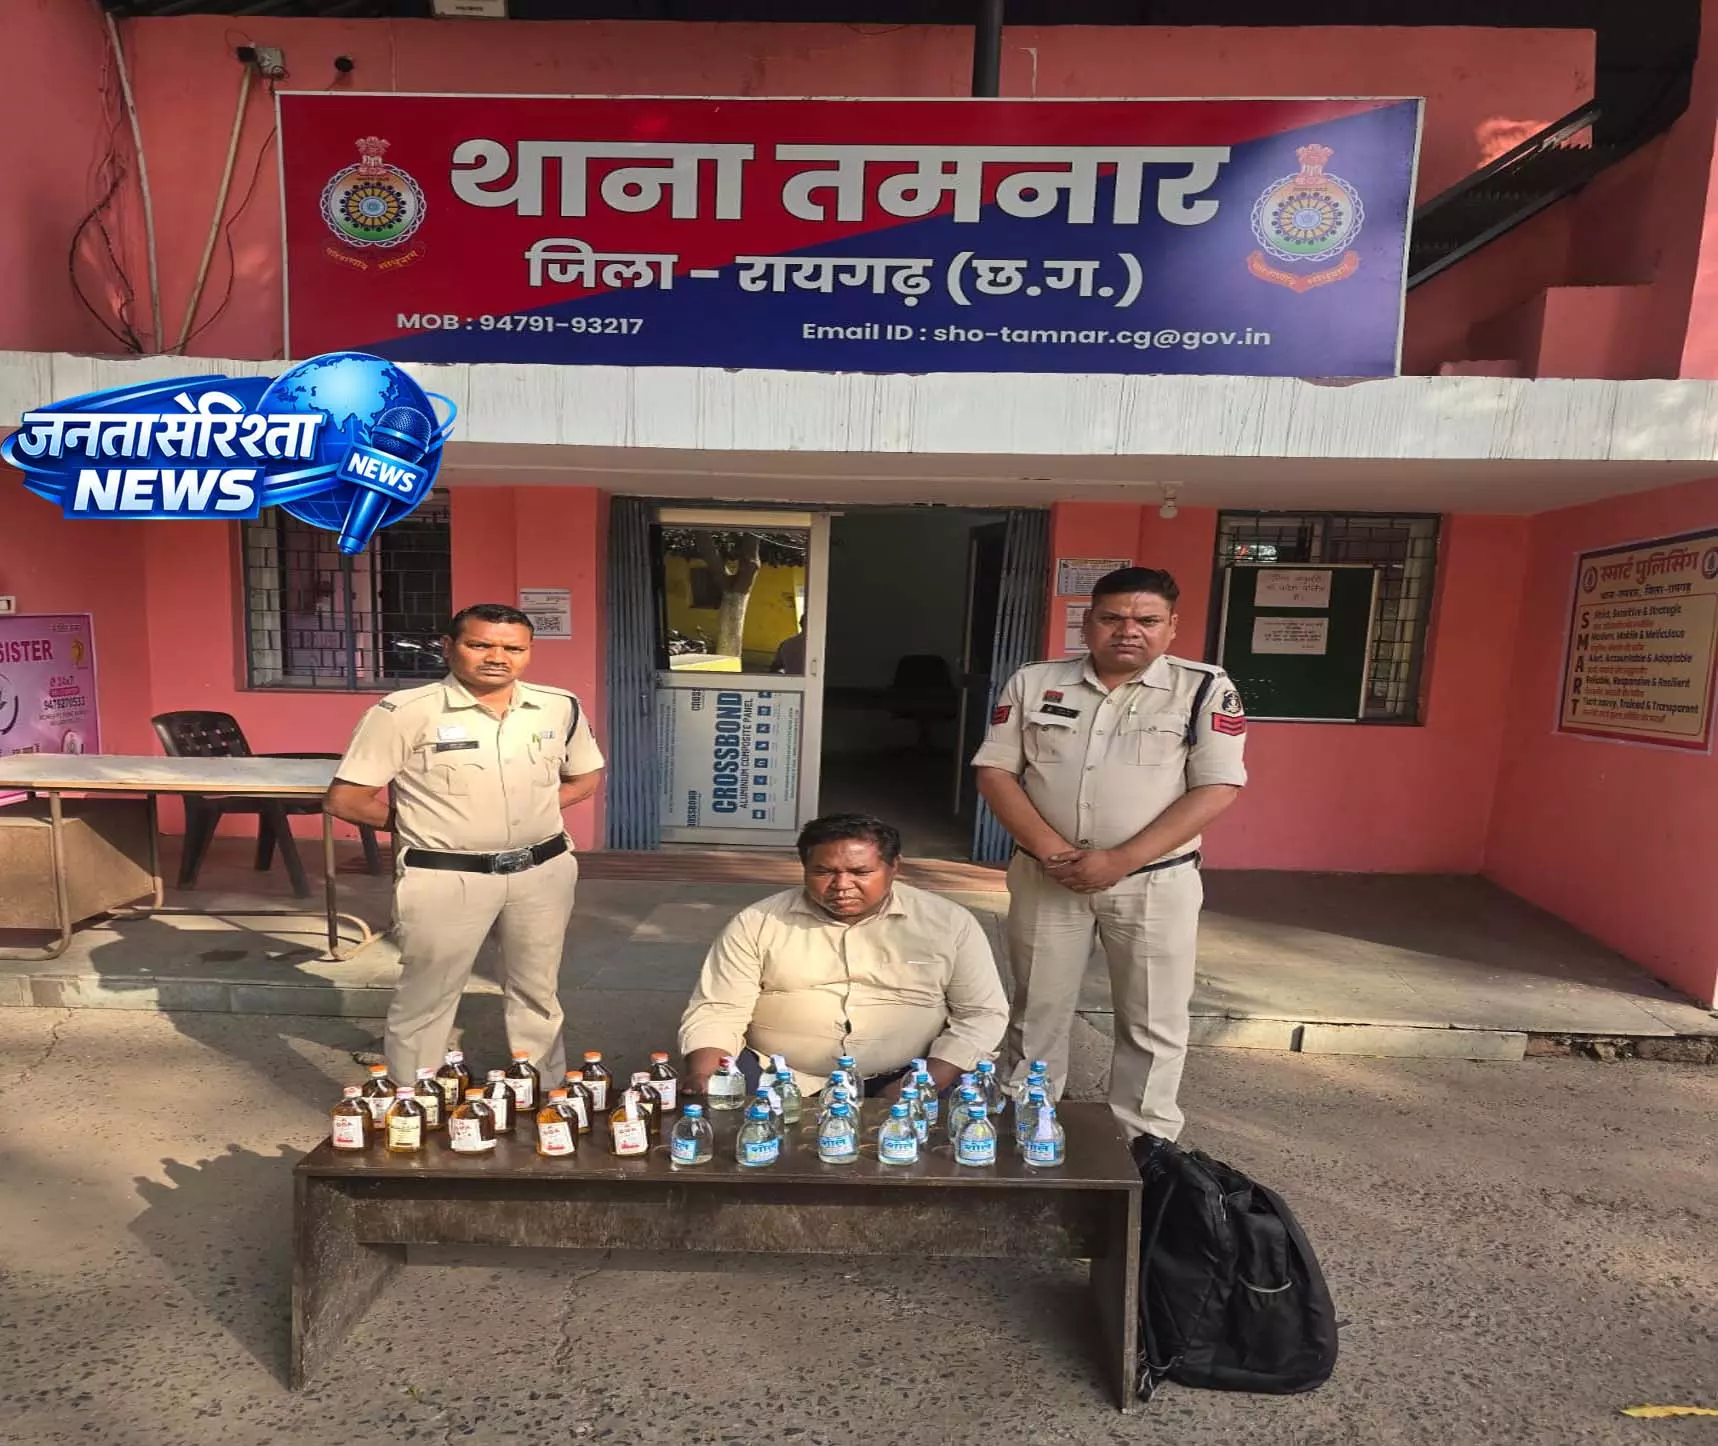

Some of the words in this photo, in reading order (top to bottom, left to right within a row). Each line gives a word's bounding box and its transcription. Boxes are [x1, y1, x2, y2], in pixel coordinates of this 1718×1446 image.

[450, 137, 756, 221] थाना
[775, 144, 1232, 227] तमनार
[525, 236, 678, 290] जिला
[737, 255, 934, 307] रायगढ़
[945, 250, 1145, 308] (छ.ग.)
[397, 312, 459, 331] MOB
[479, 314, 644, 335] 94791-93217
[802, 323, 880, 341] Email
[886, 324, 914, 341] ID
[933, 325, 1271, 350] sho-tamnar.cg@gov.in
[1599, 555, 1634, 582] स्मार्ट
[1635, 547, 1699, 584] पुलिसिंग
[1580, 611, 1590, 629] S
[0, 639, 54, 663] ISTER
[1576, 633, 1590, 651] M
[1574, 655, 1584, 673] A
[1572, 677, 1583, 695] R
[742, 698, 753, 723] PANEL
[1571, 698, 1581, 717] T
[1652, 700, 1699, 715] Transparent
[711, 692, 742, 814] CROSSBOND
[741, 724, 752, 767] COMPOSITE
[739, 768, 750, 809] ALUMINIUM
